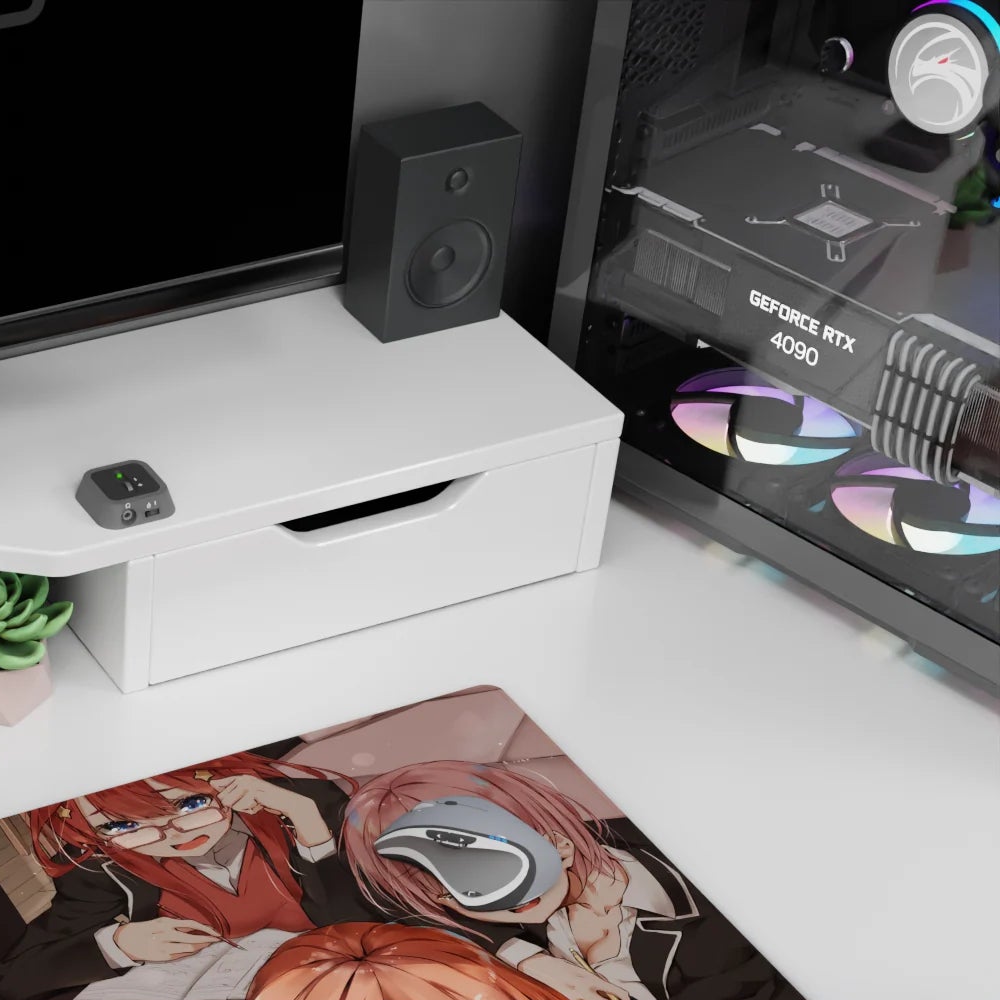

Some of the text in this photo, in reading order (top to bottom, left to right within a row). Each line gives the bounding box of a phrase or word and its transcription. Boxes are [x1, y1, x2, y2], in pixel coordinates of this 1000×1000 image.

[750, 289, 857, 354] GEFORCE RTX
[770, 331, 819, 367] 4090
